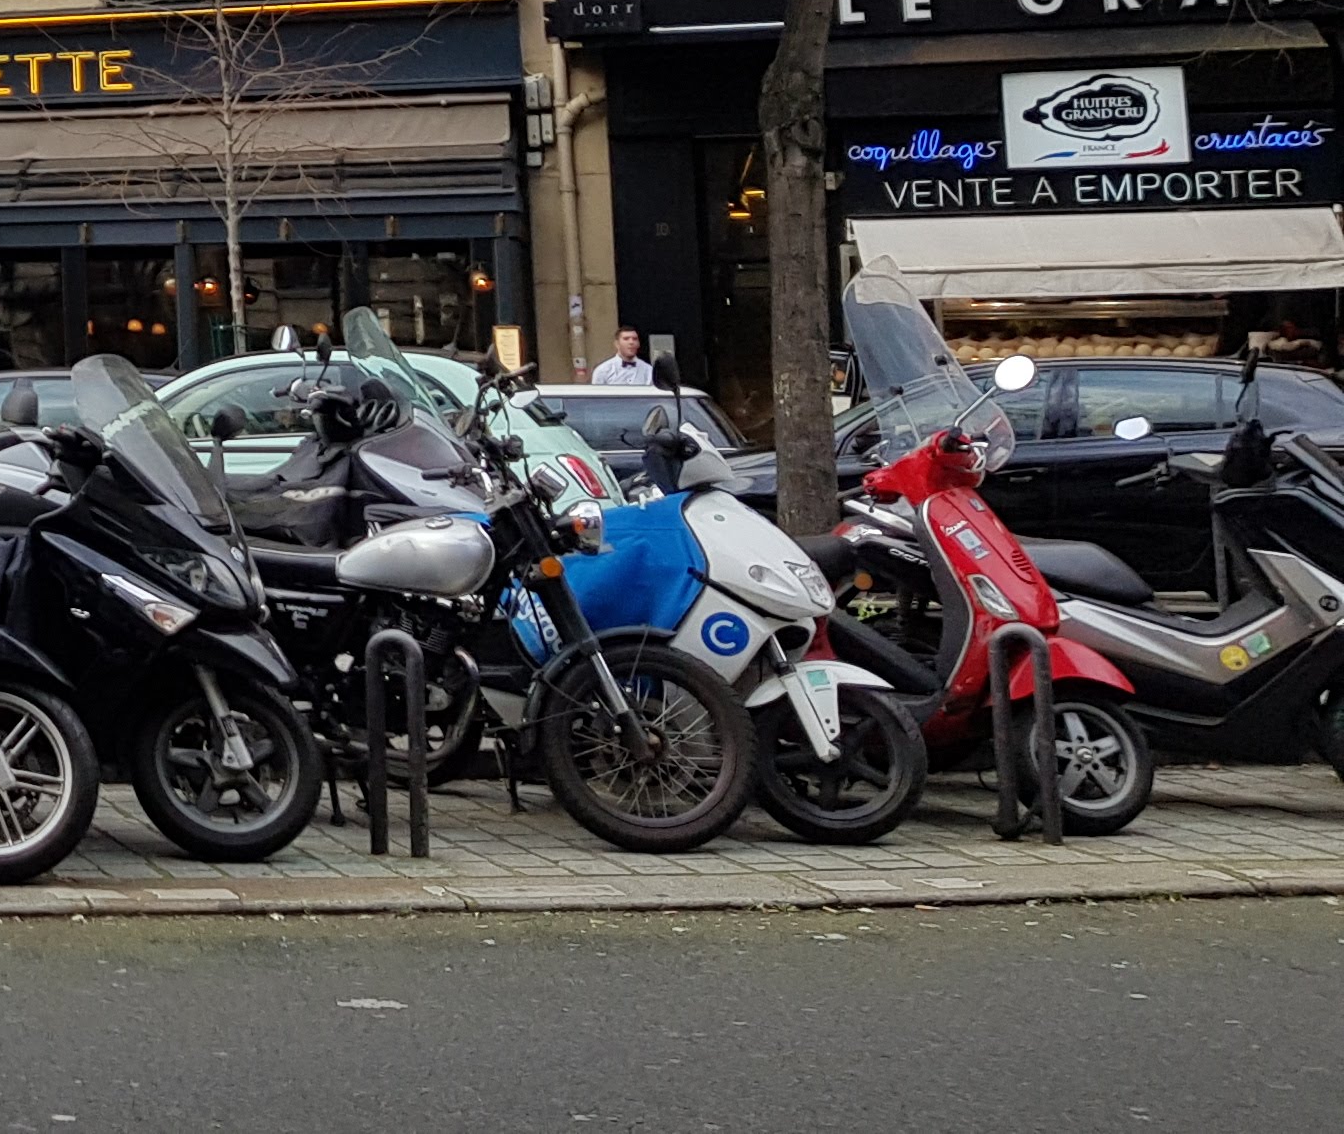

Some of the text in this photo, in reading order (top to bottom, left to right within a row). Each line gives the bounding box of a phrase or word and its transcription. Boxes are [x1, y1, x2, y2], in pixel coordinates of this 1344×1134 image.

[573, 2, 633, 15] dorr
[1073, 96, 1132, 109] HUITRES
[1062, 106, 1145, 121] GRAND CRU
[848, 128, 1003, 171] coquillages
[1082, 144, 1116, 152] FRANCE
[884, 168, 1302, 209] VENTE A EMPORTER
